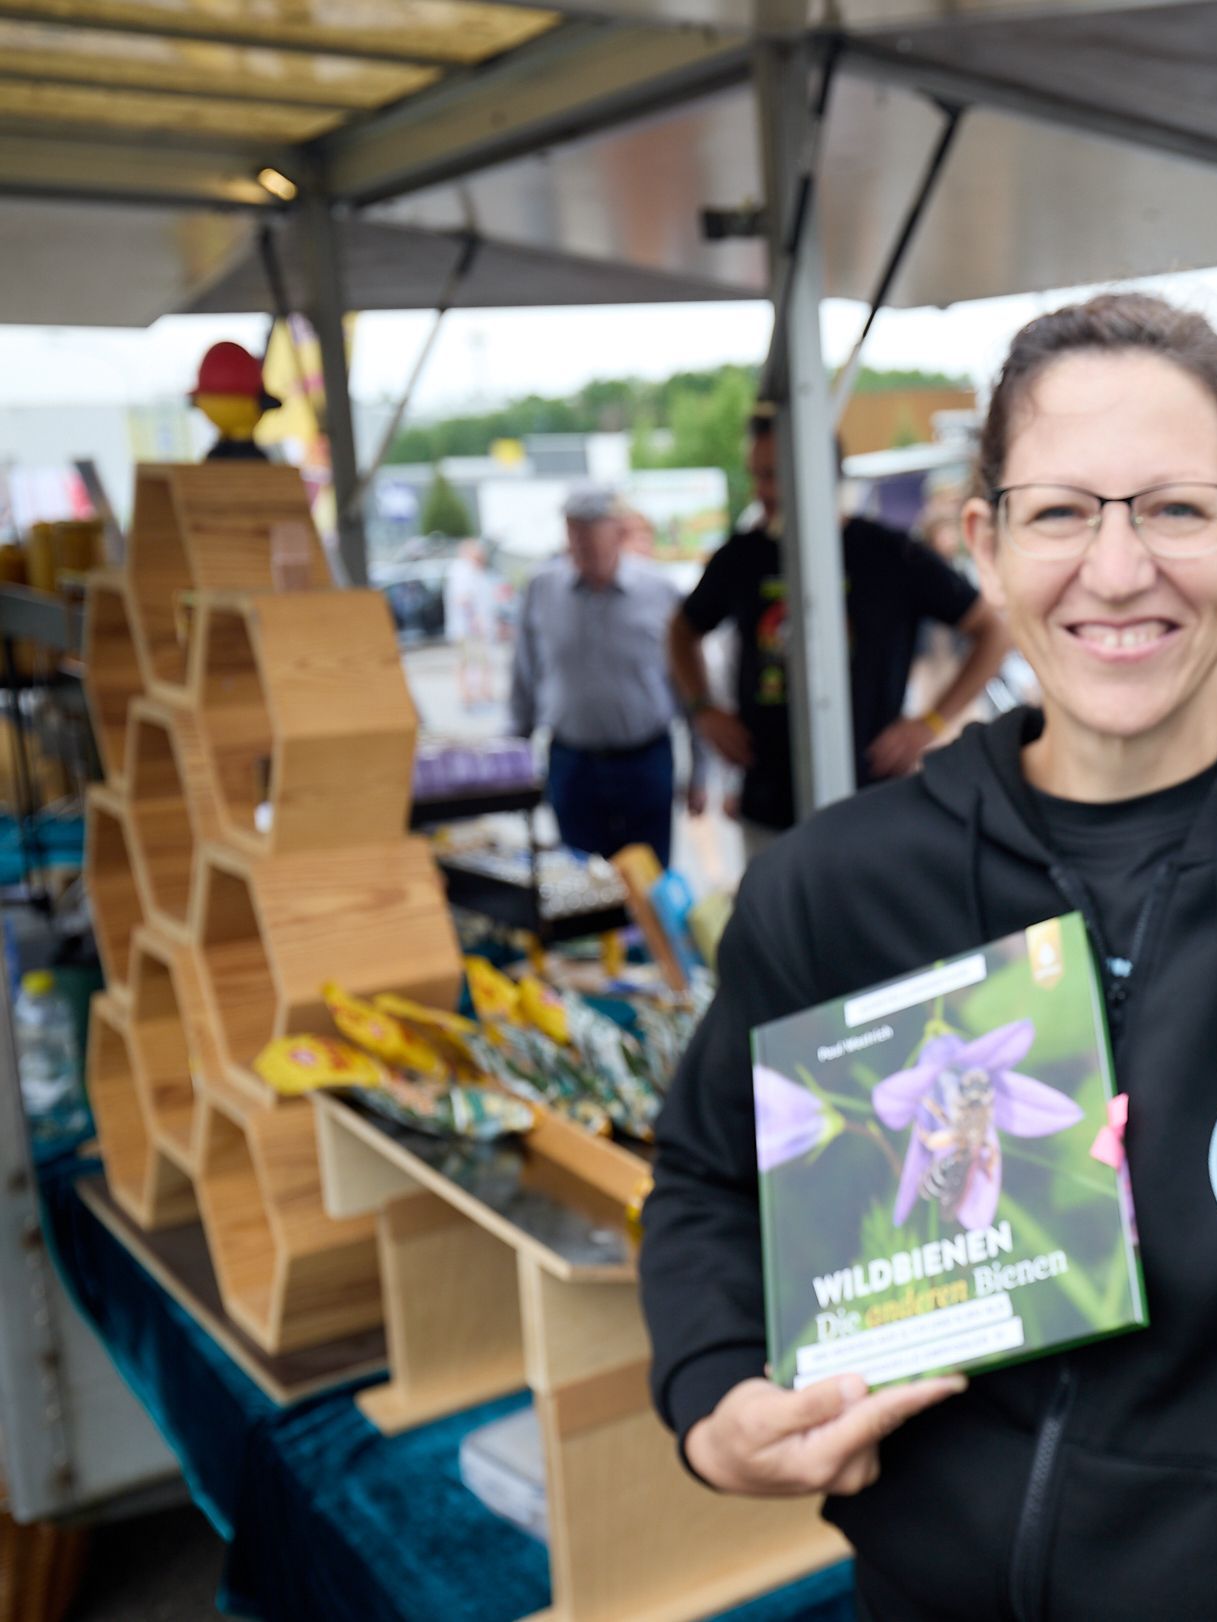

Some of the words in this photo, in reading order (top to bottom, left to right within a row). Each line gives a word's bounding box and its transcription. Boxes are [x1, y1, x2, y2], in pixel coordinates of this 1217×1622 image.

[812, 1219, 1013, 1308] WILDBIENEN
[815, 1307, 862, 1343] Die
[972, 1249, 1069, 1299] Bienen
